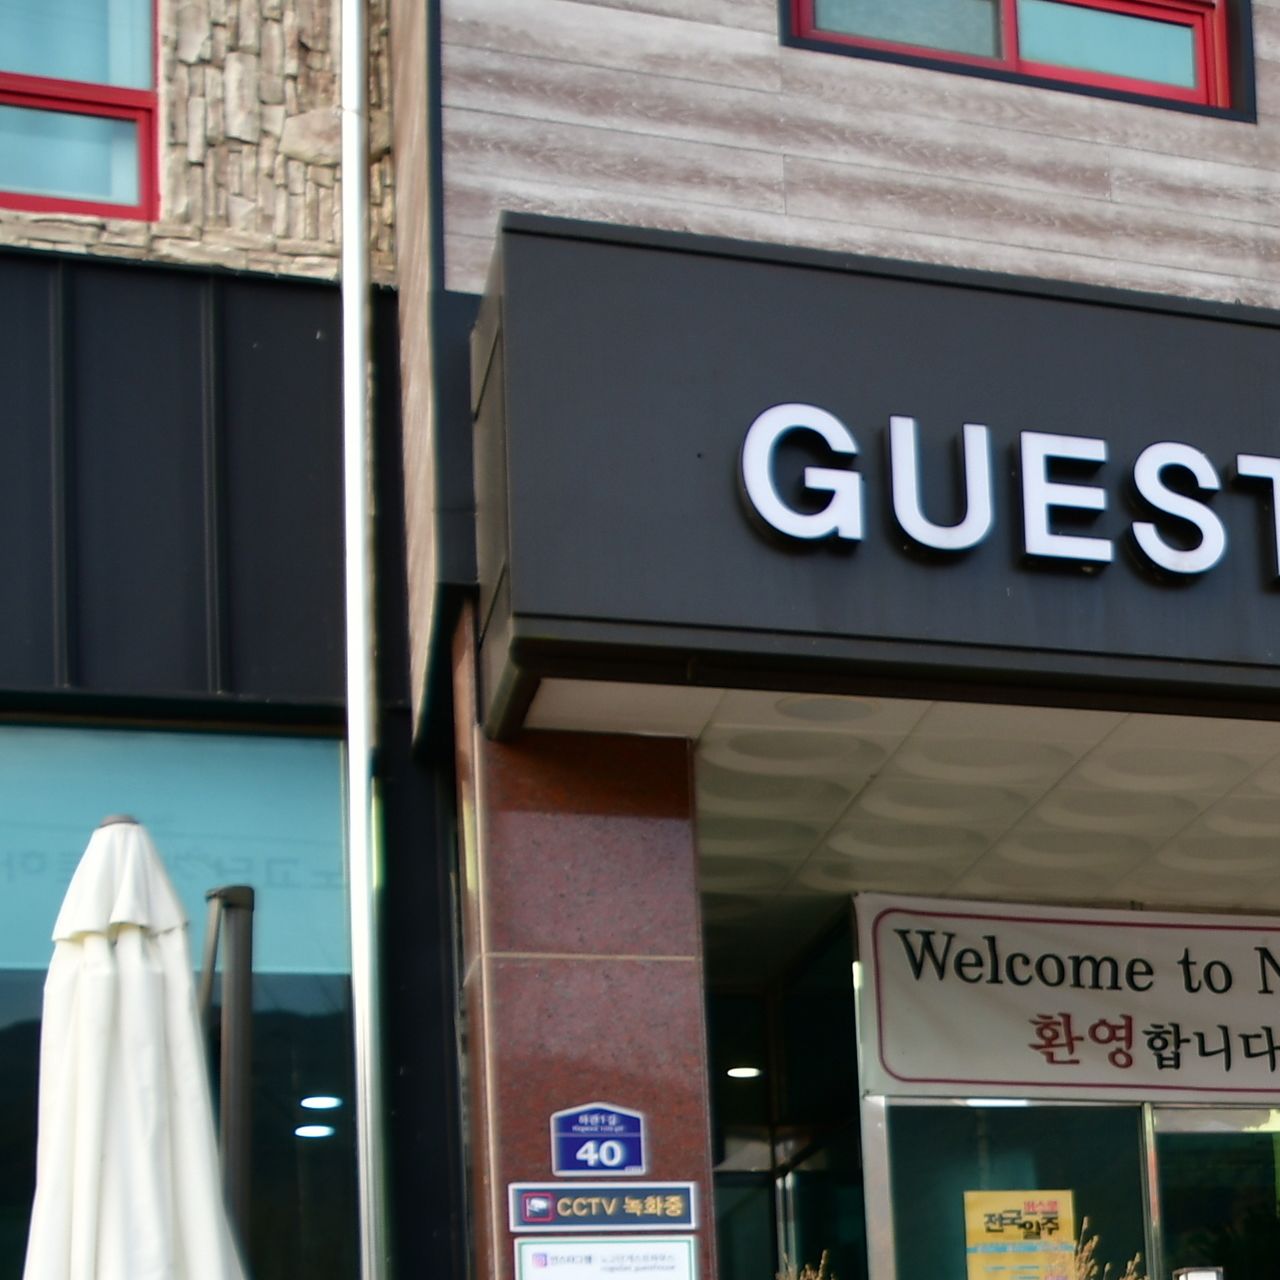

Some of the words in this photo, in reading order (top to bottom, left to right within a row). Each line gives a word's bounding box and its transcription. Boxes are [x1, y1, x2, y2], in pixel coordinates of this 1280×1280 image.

[893, 927, 1155, 993] Welcome
[1177, 945, 1234, 996] to
[576, 1140, 623, 1167] 40
[557, 1197, 618, 1217] CCTV
[624, 1195, 684, 1218] 녹화중
